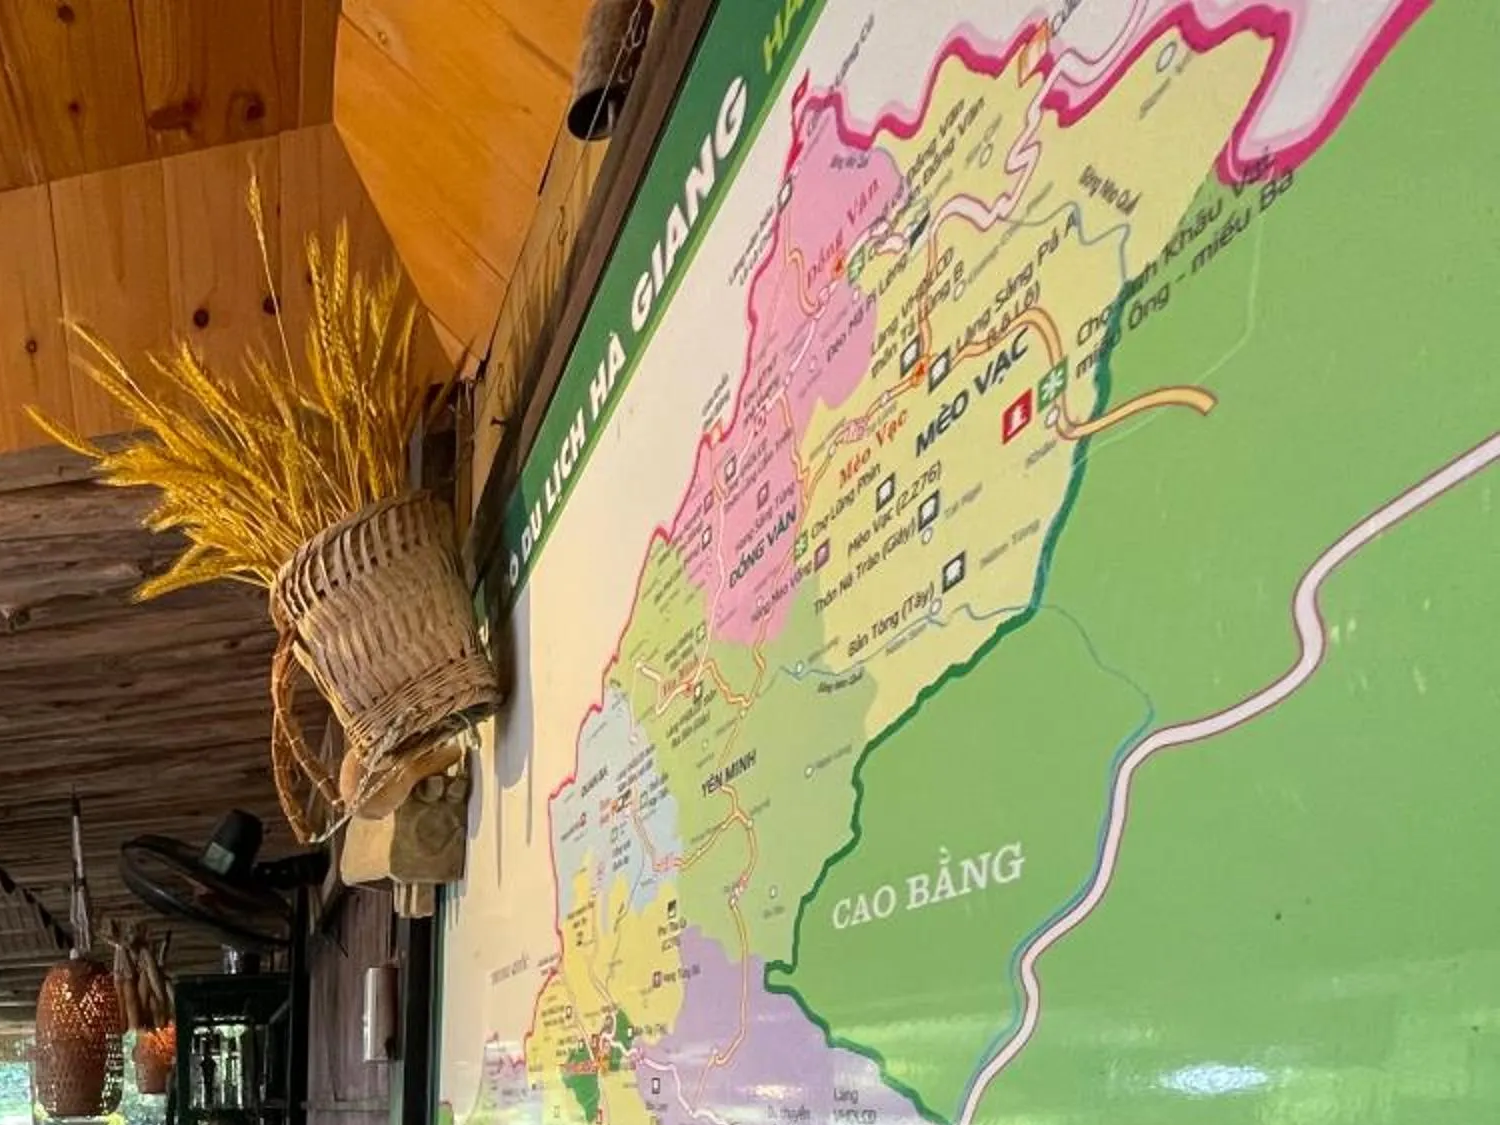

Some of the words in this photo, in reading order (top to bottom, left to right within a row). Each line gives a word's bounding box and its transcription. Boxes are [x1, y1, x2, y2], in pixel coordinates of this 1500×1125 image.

[521, 499, 542, 564] DU
[545, 406, 586, 513] LỊCH
[590, 332, 627, 423] HÀ
[631, 76, 748, 330] GIANG
[916, 388, 970, 459] MÈO
[973, 327, 1029, 396] VẠC
[831, 886, 896, 930] CAO
[905, 842, 1026, 912] BẰNG
